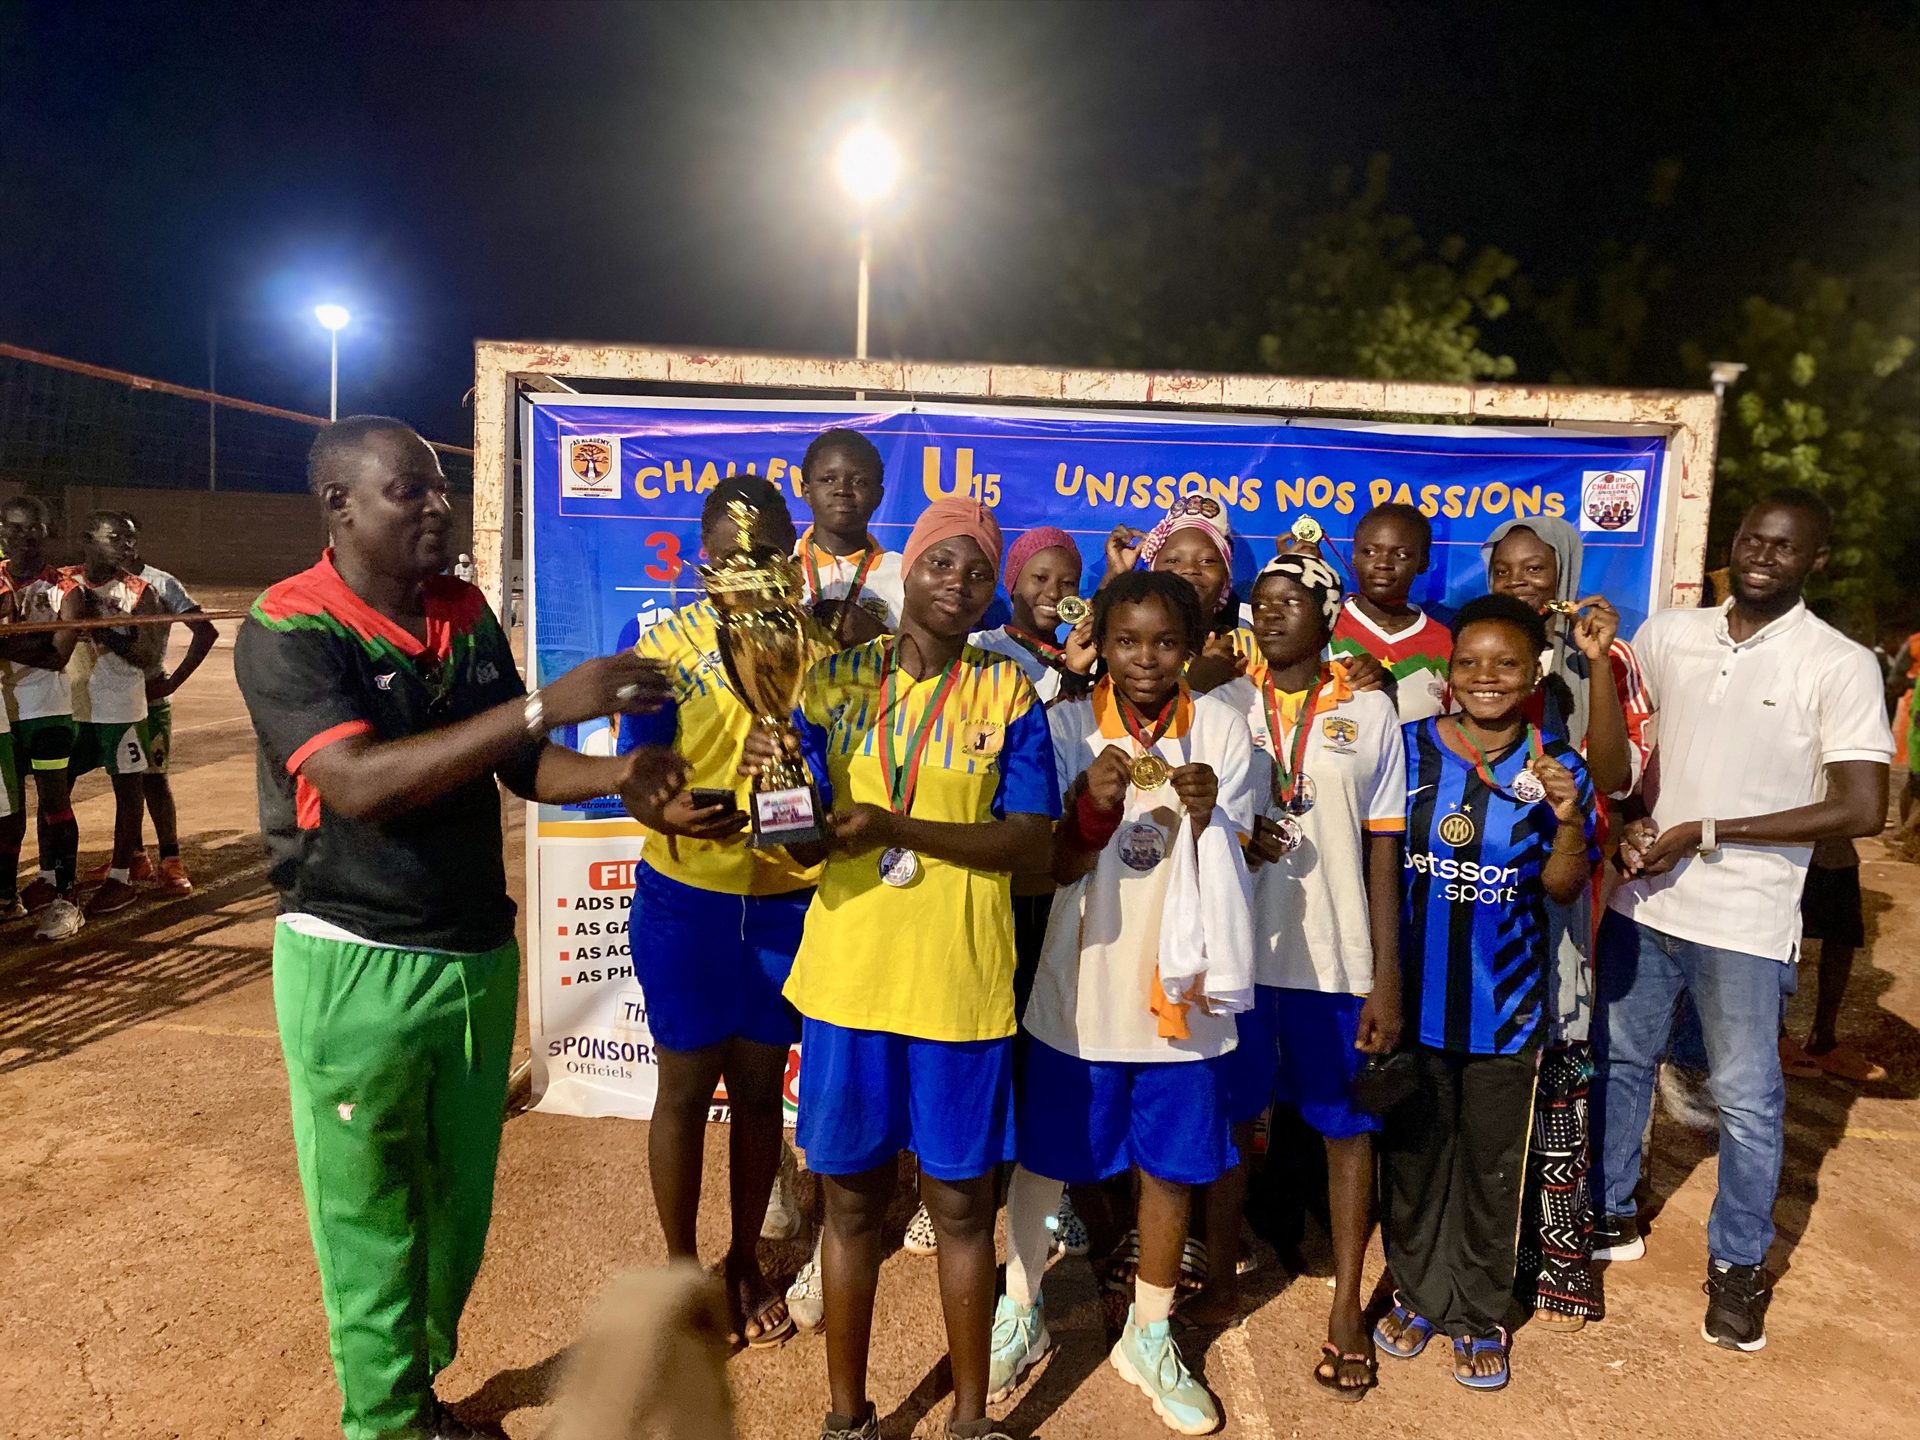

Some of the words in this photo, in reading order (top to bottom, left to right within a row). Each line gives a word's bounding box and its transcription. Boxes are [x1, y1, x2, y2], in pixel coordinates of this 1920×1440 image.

[1055, 462, 1262, 512] UNISSONS
[1275, 475, 1356, 515] NOS
[1369, 478, 1566, 519] PASSIONS
[1592, 482, 1635, 490] CHALLENGE
[644, 531, 682, 582] 3
[128, 742, 141, 763] 3
[575, 896, 615, 910] ADS
[575, 921, 601, 936] AS
[576, 946, 601, 961] AS
[577, 969, 602, 984] AS
[566, 1061, 632, 1079] Officiels
